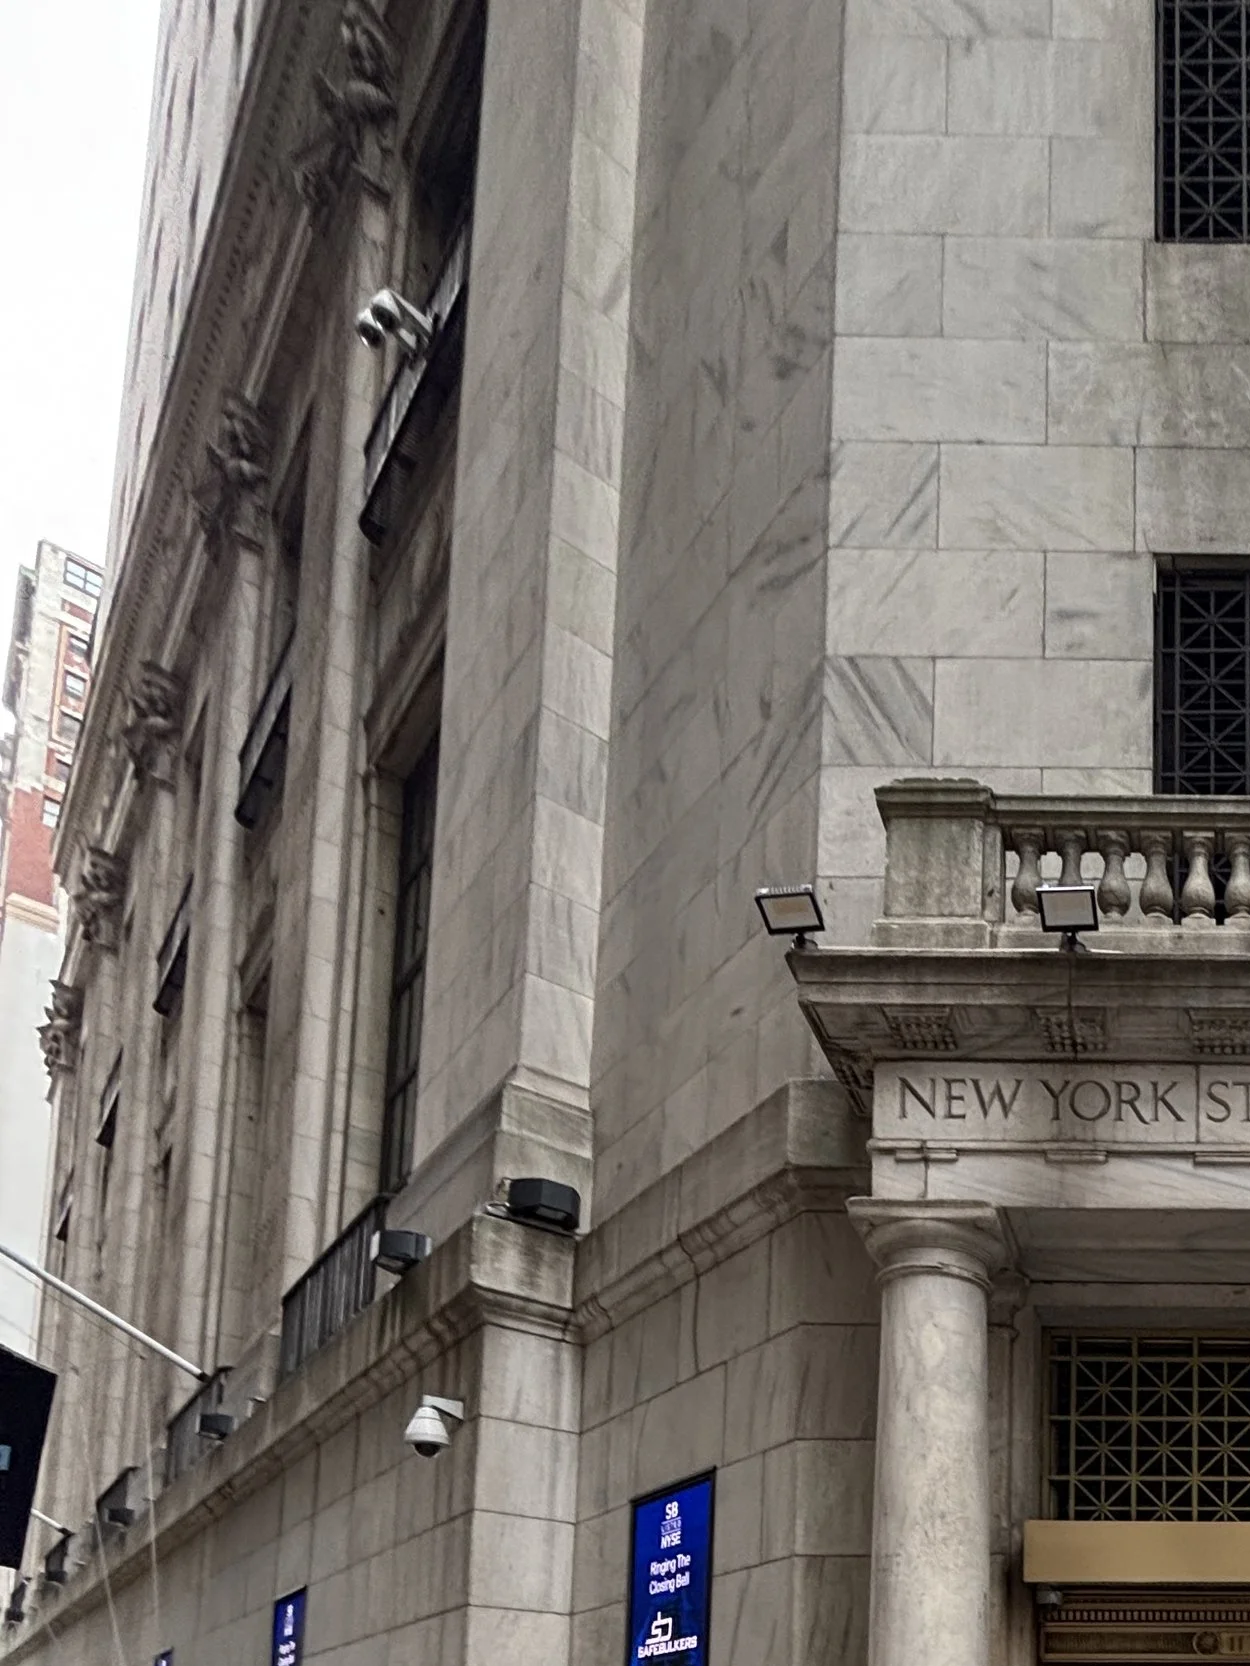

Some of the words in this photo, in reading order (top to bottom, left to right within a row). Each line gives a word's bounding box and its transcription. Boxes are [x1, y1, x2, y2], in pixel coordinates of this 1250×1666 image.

[898, 1075, 1024, 1120] NEW
[1039, 1078, 1187, 1126] YORK
[665, 1501, 679, 1520] SB
[660, 1531, 682, 1549] NYSE
[650, 1557, 676, 1577] Ringing
[676, 1553, 691, 1569] The
[649, 1577, 675, 1595] Closing
[675, 1571, 691, 1589] Bell
[1229, 1635, 1243, 1653] 11
